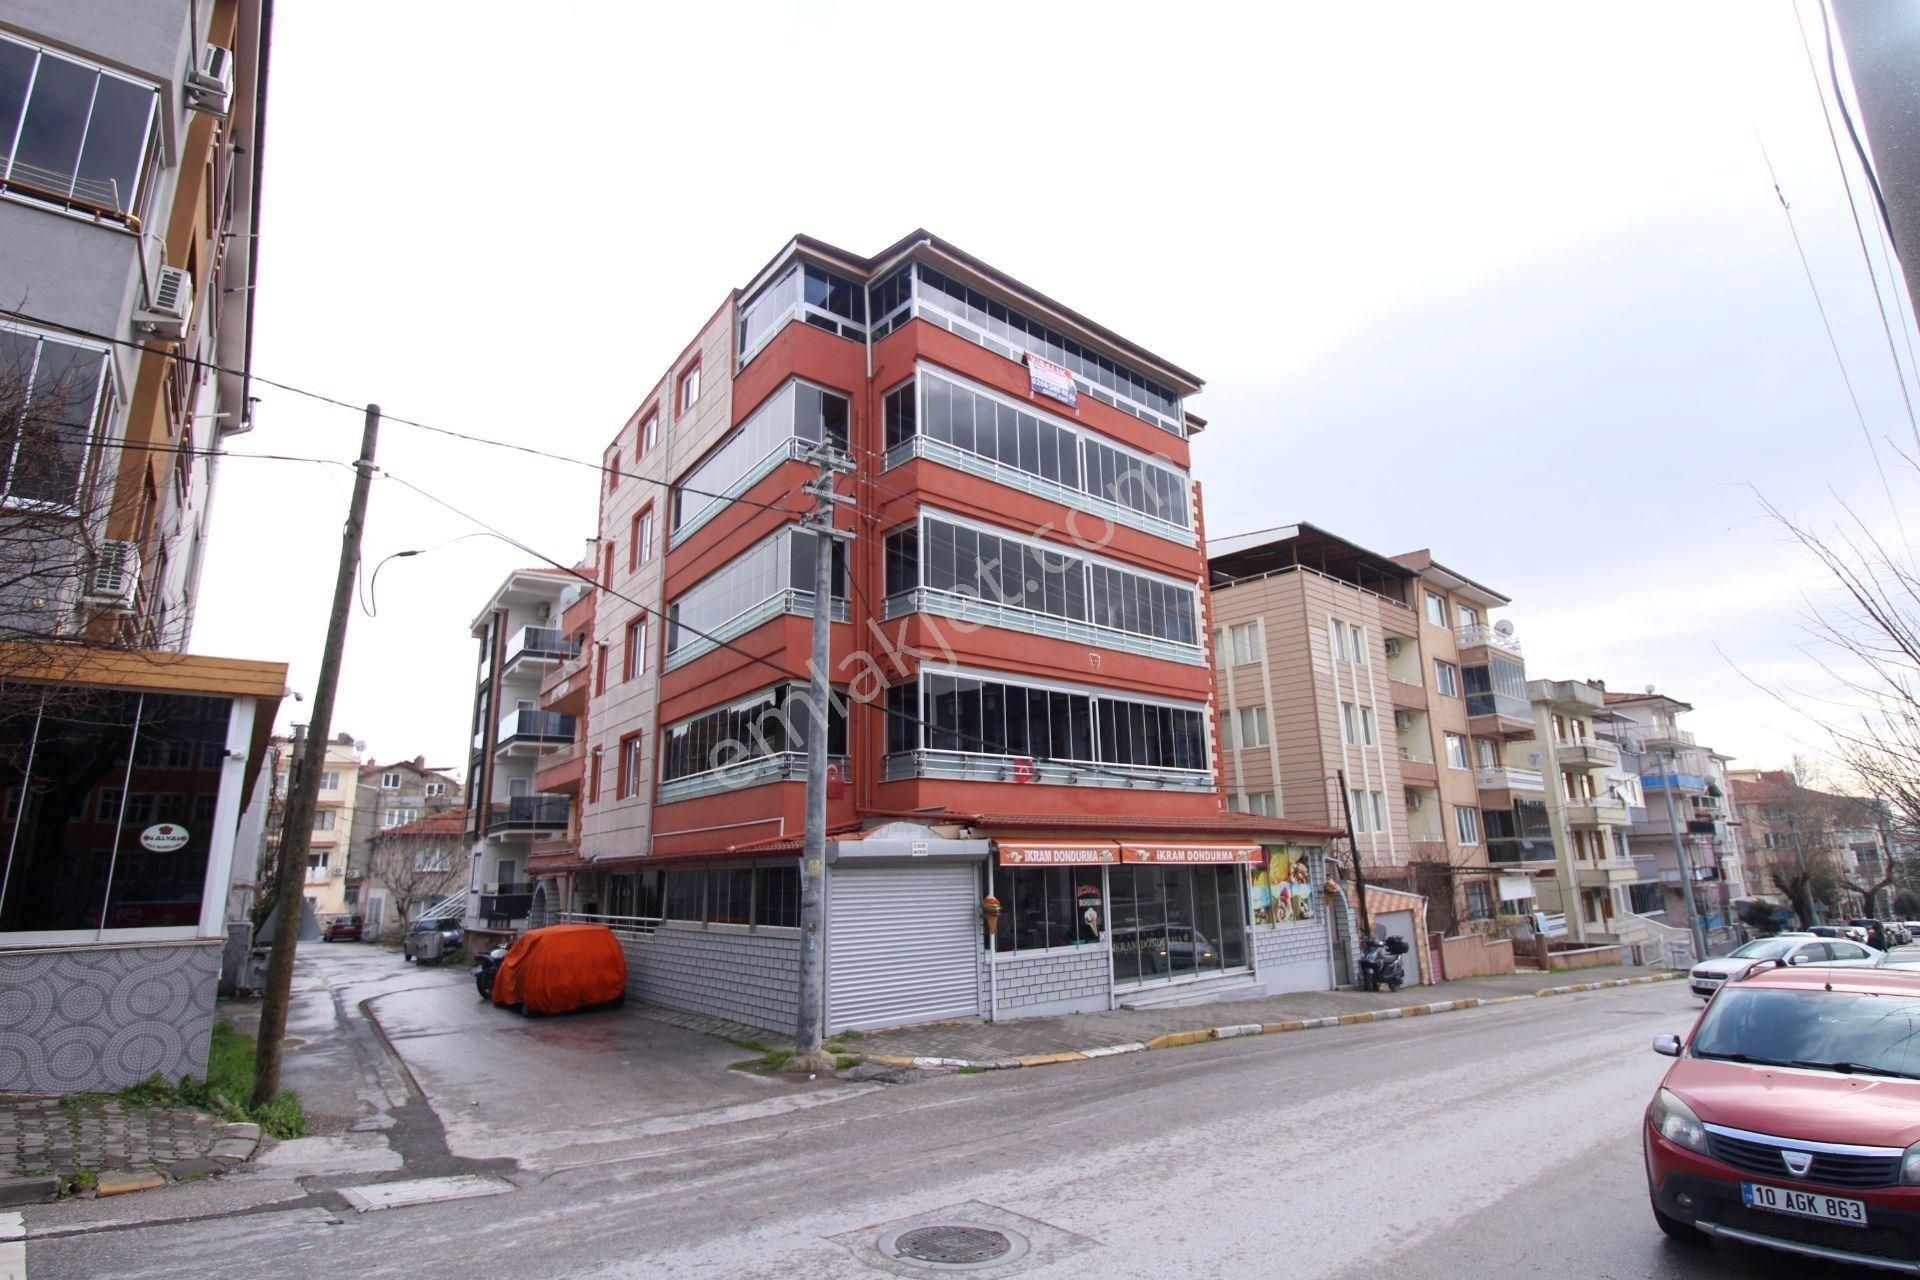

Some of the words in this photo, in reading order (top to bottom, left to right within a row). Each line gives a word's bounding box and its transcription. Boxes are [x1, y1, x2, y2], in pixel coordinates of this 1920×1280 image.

[1053, 849, 1098, 862] DONDURMA
[1187, 850, 1234, 861] DONDURMA
[1756, 1186, 1776, 1206] 10
[1785, 1191, 1818, 1214] AGK
[1826, 1198, 1862, 1220] 863
